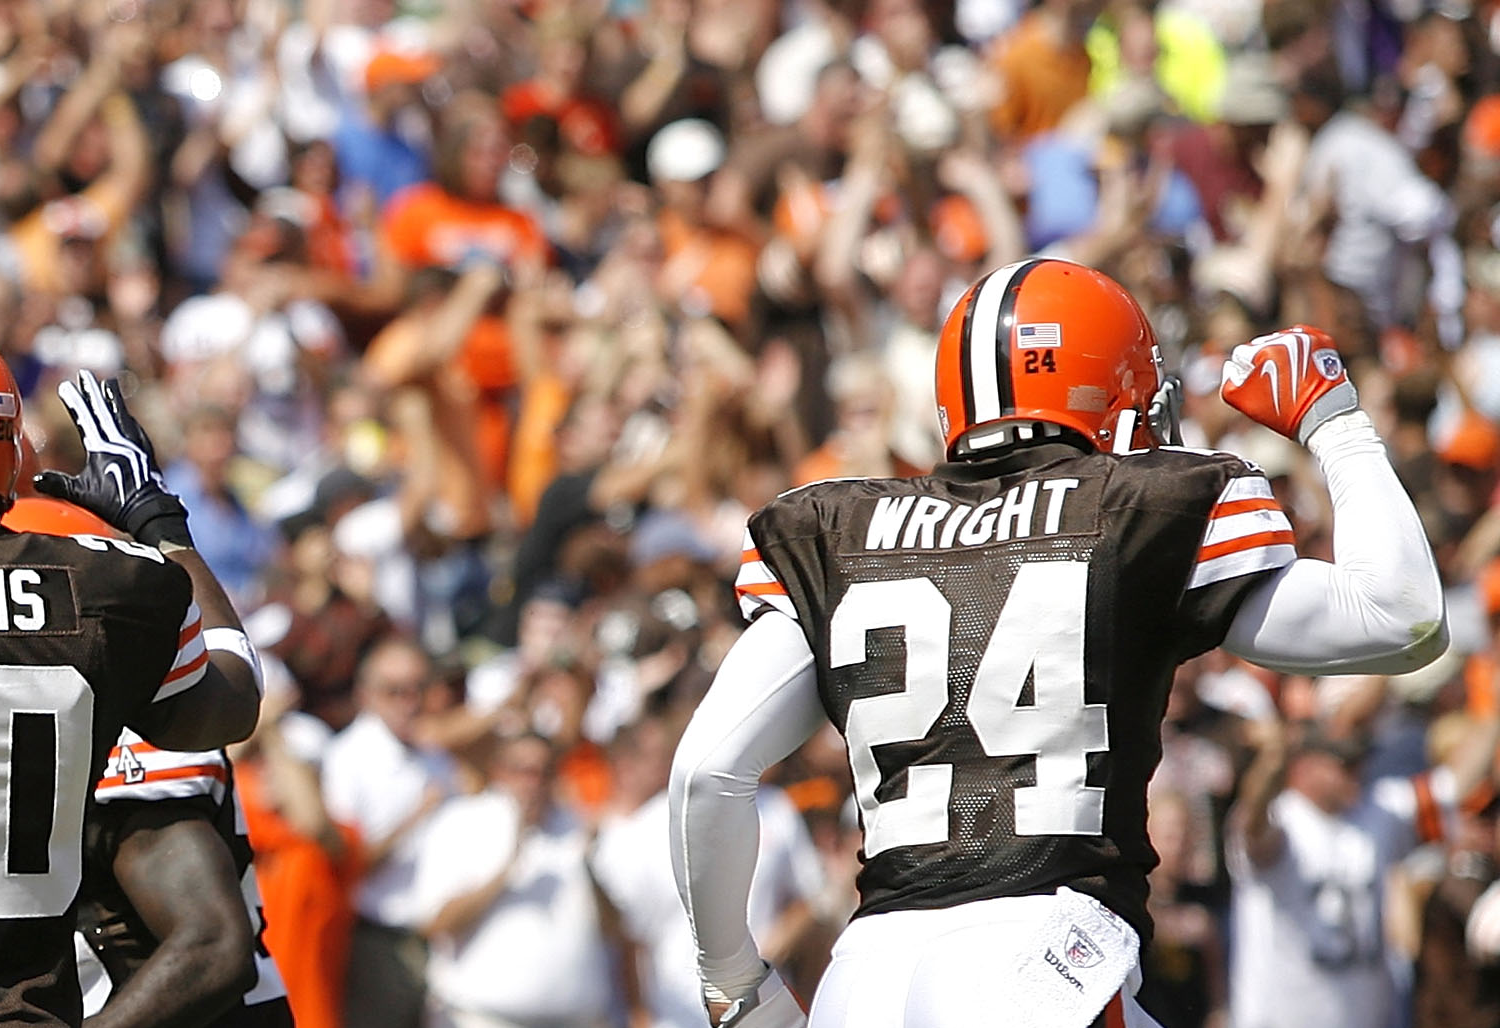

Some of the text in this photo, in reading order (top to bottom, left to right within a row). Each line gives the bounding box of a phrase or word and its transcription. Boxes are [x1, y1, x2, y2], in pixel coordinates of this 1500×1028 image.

[1024, 349, 1057, 374] 24
[864, 477, 1079, 551] WRIGHT
[828, 559, 1109, 859] 24
